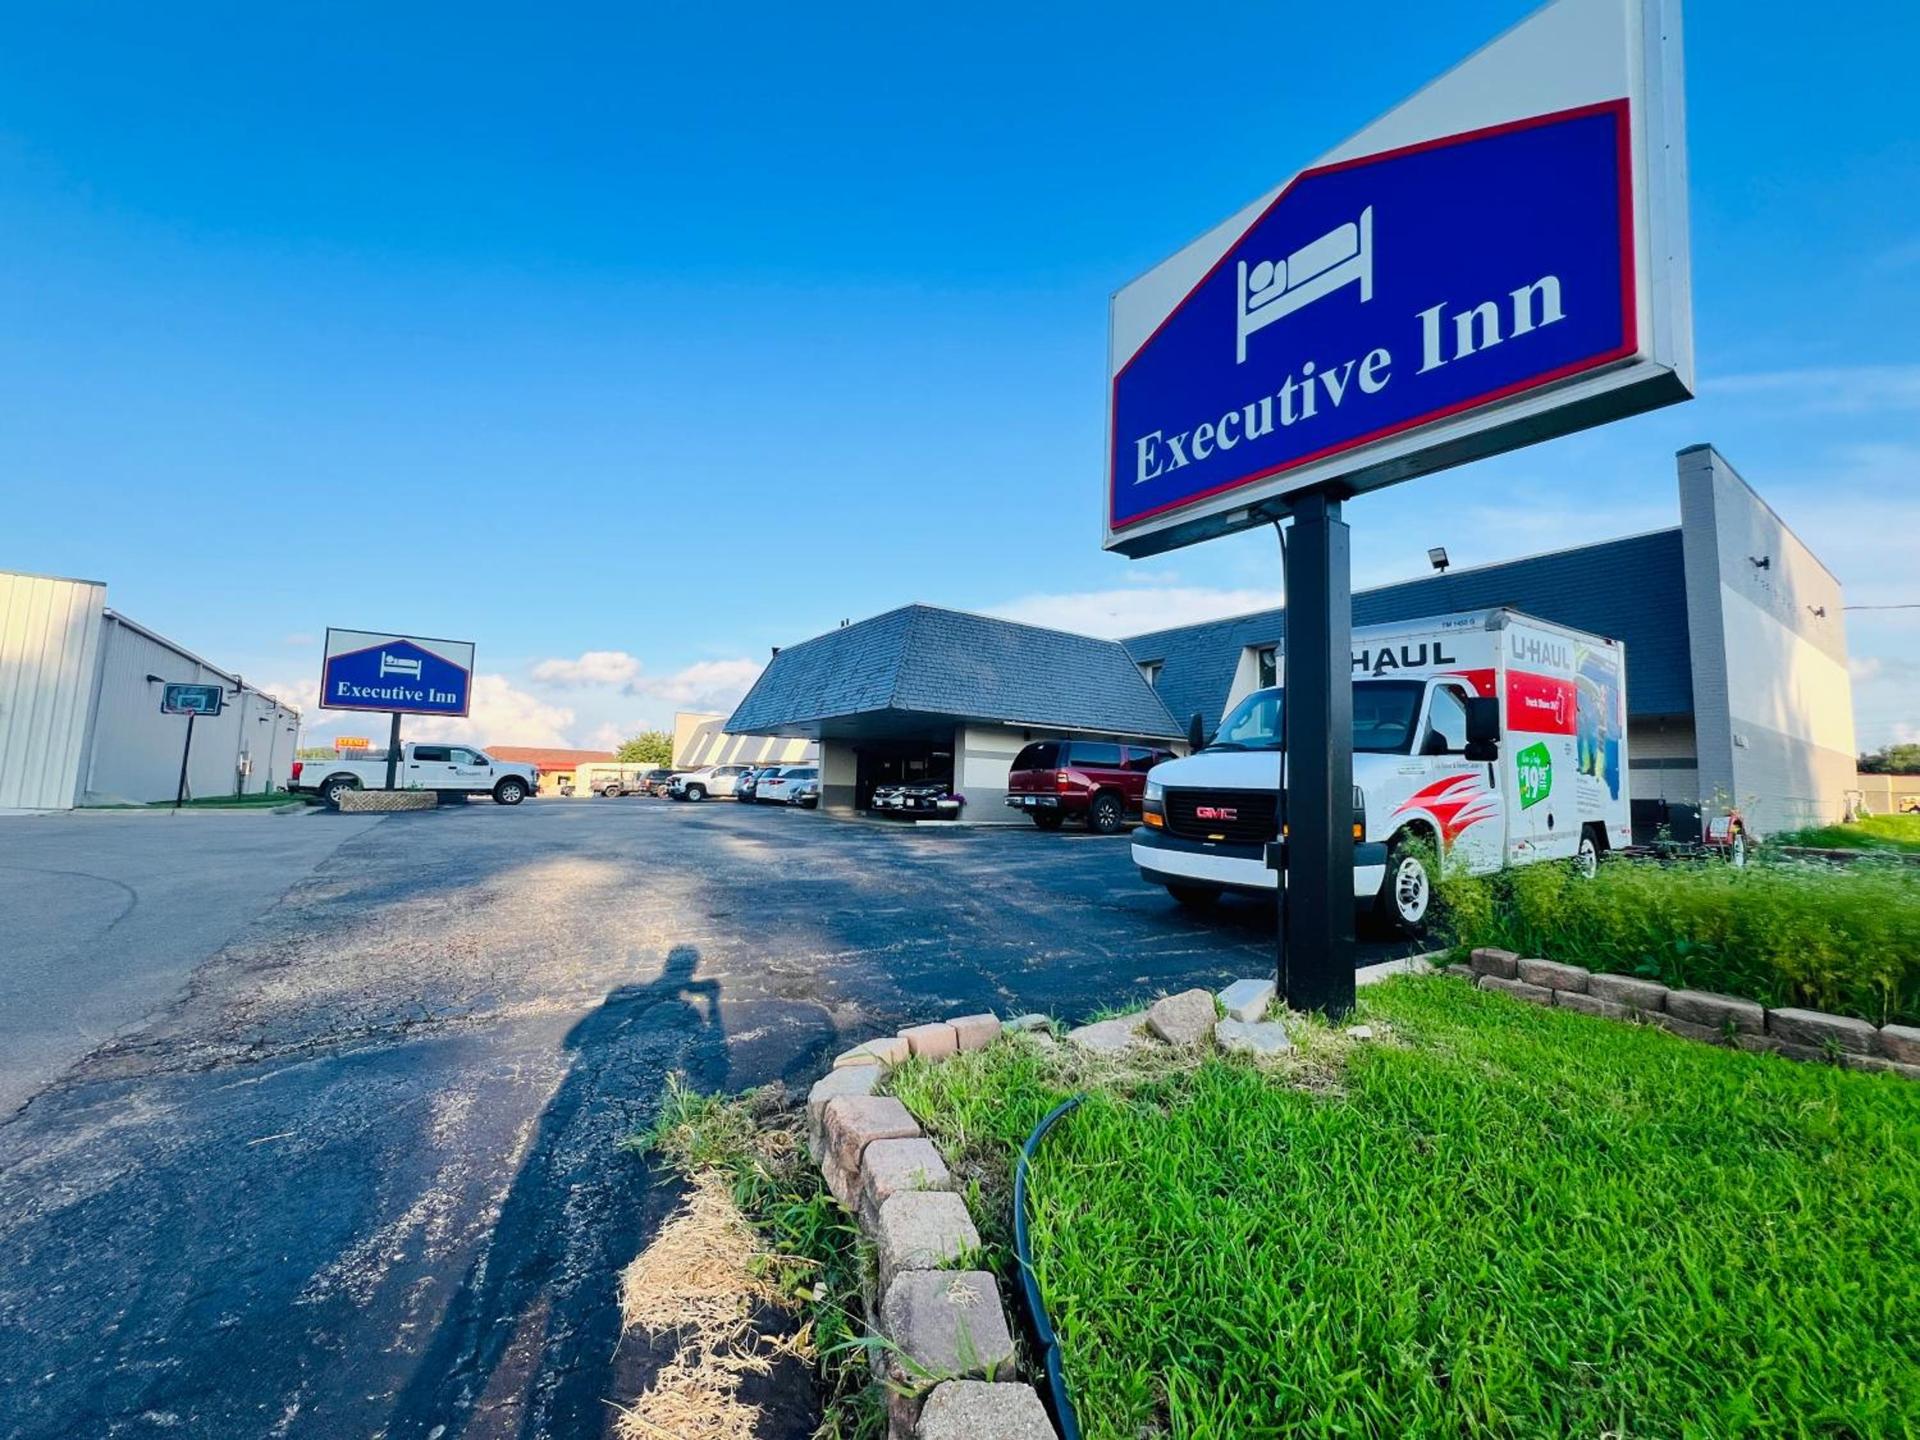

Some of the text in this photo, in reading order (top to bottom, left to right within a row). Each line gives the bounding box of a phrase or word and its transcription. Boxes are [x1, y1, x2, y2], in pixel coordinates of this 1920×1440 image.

[1133, 275, 1567, 485] Executive Inn
[1511, 634, 1570, 670] U-HAUL
[336, 681, 457, 703] Executive Inn
[1196, 806, 1238, 819] GMC
